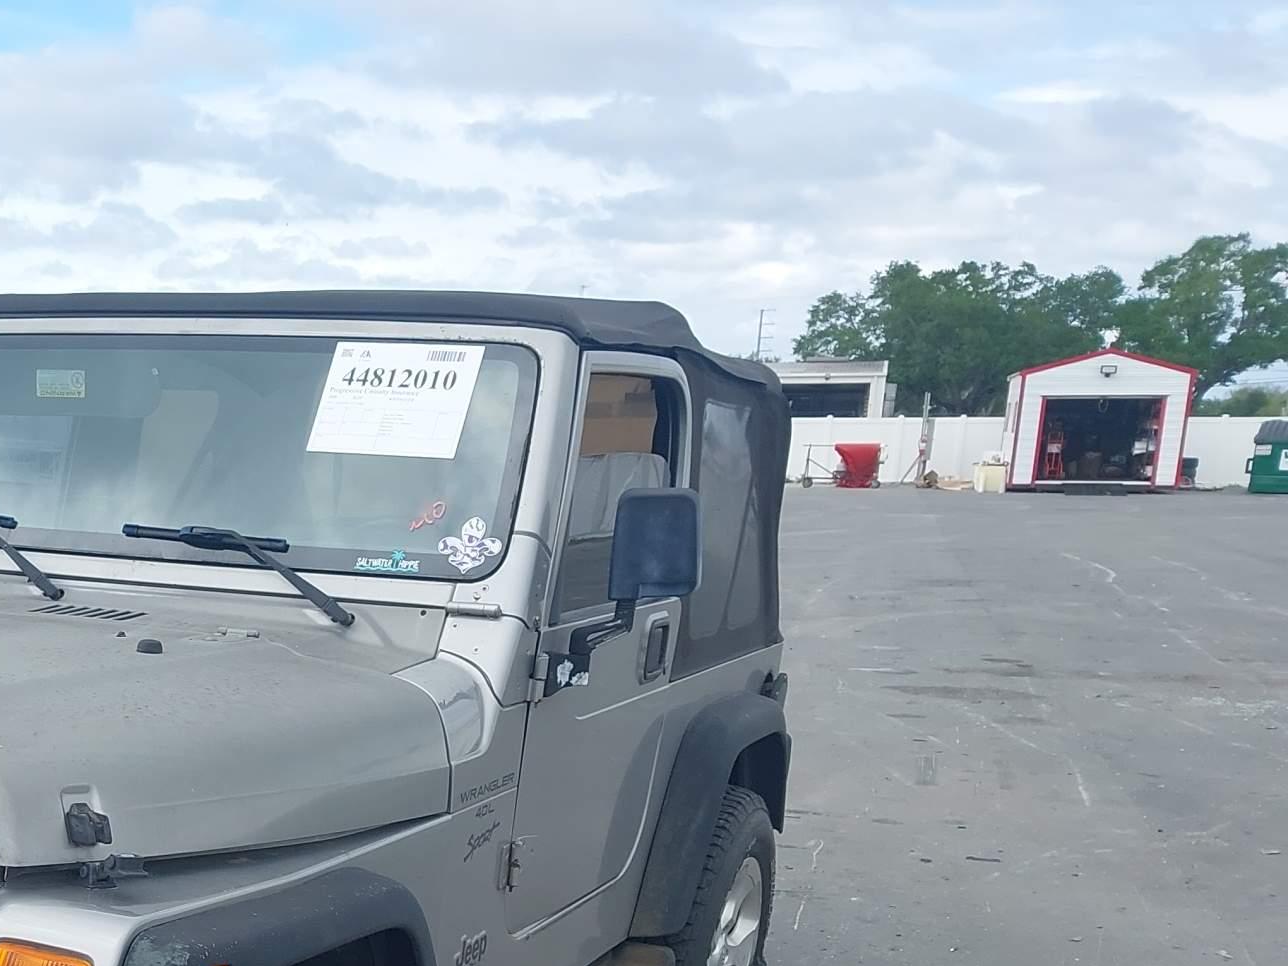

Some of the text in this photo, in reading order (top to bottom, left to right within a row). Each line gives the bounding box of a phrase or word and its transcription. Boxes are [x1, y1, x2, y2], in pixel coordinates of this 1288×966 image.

[342, 367, 457, 390] 44812010
[356, 557, 392, 568] SALTWATER
[460, 773, 515, 803] WRANGLER
[463, 821, 500, 862] Sport
